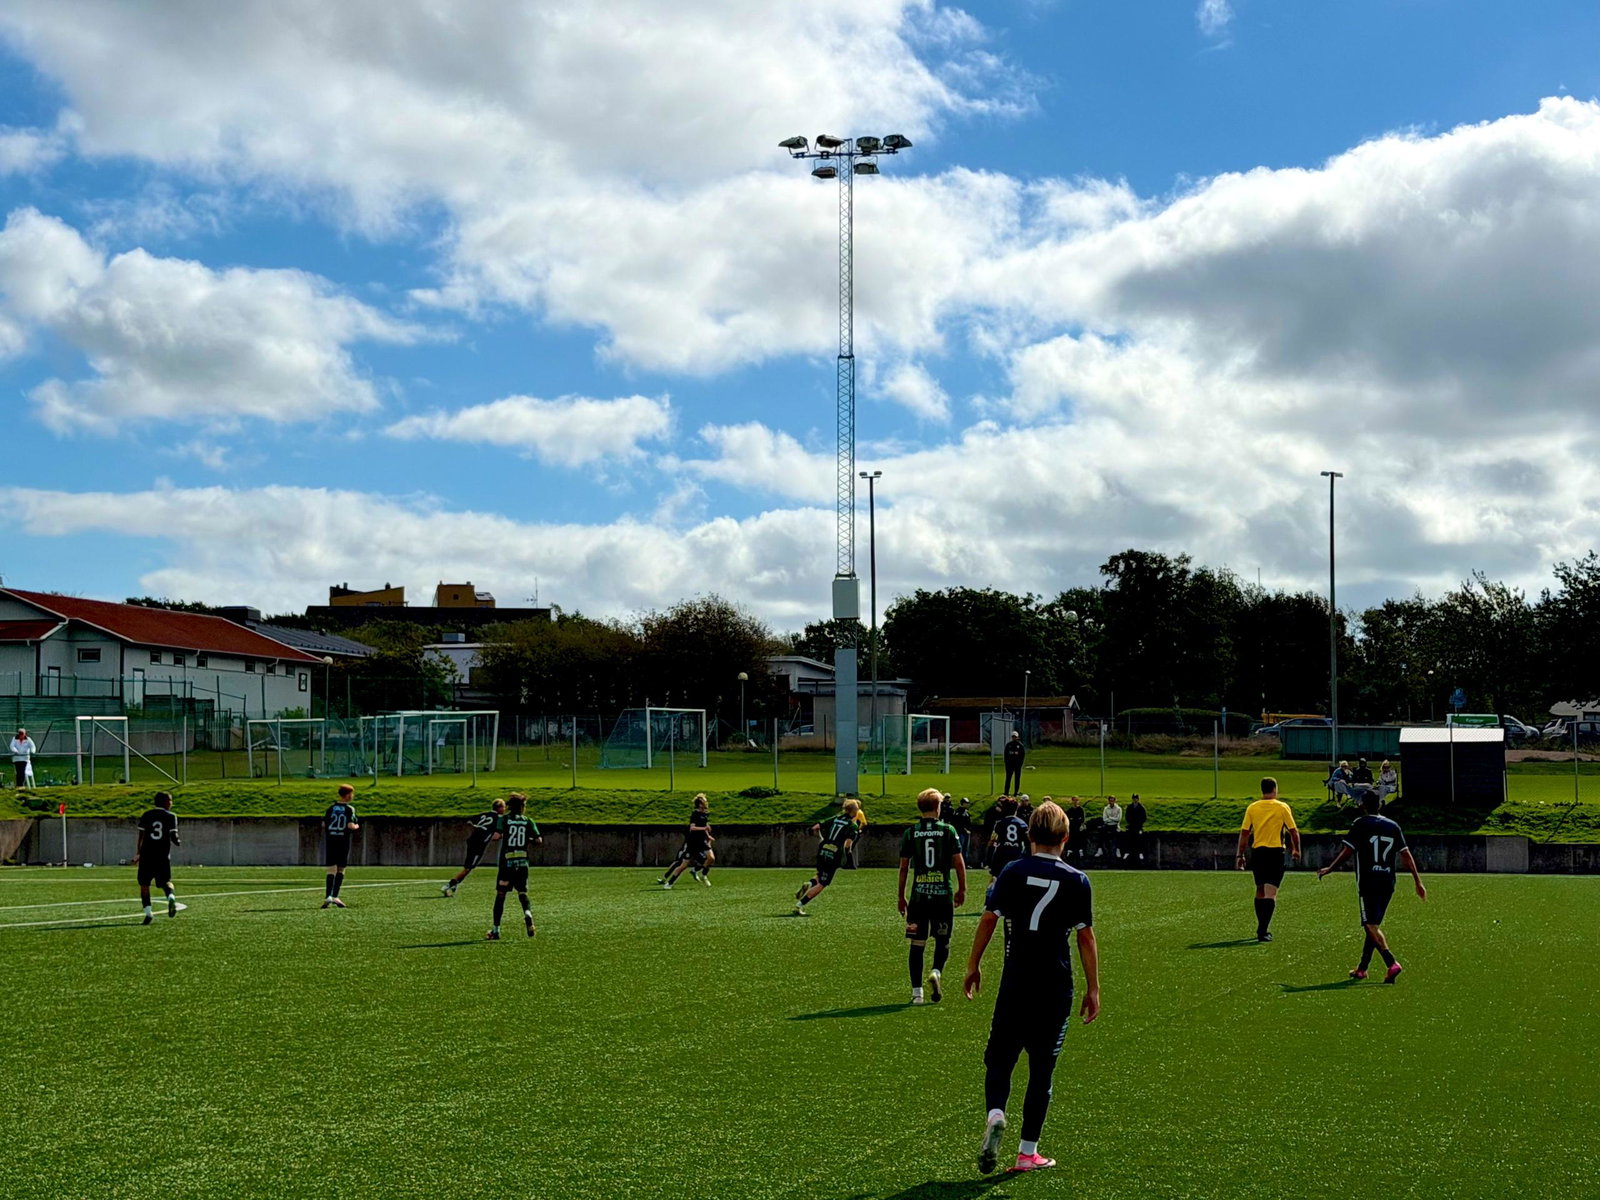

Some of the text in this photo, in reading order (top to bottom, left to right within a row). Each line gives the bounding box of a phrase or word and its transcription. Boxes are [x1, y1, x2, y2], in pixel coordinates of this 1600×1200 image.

[150, 821, 163, 840] 3
[328, 813, 347, 831] 20
[474, 815, 494, 831] 22
[828, 823, 845, 841] 17
[913, 830, 944, 838] Derome
[1006, 824, 1018, 842] 8
[924, 838, 935, 868] 6
[1369, 835, 1394, 863] 17
[1026, 876, 1060, 931] 7
